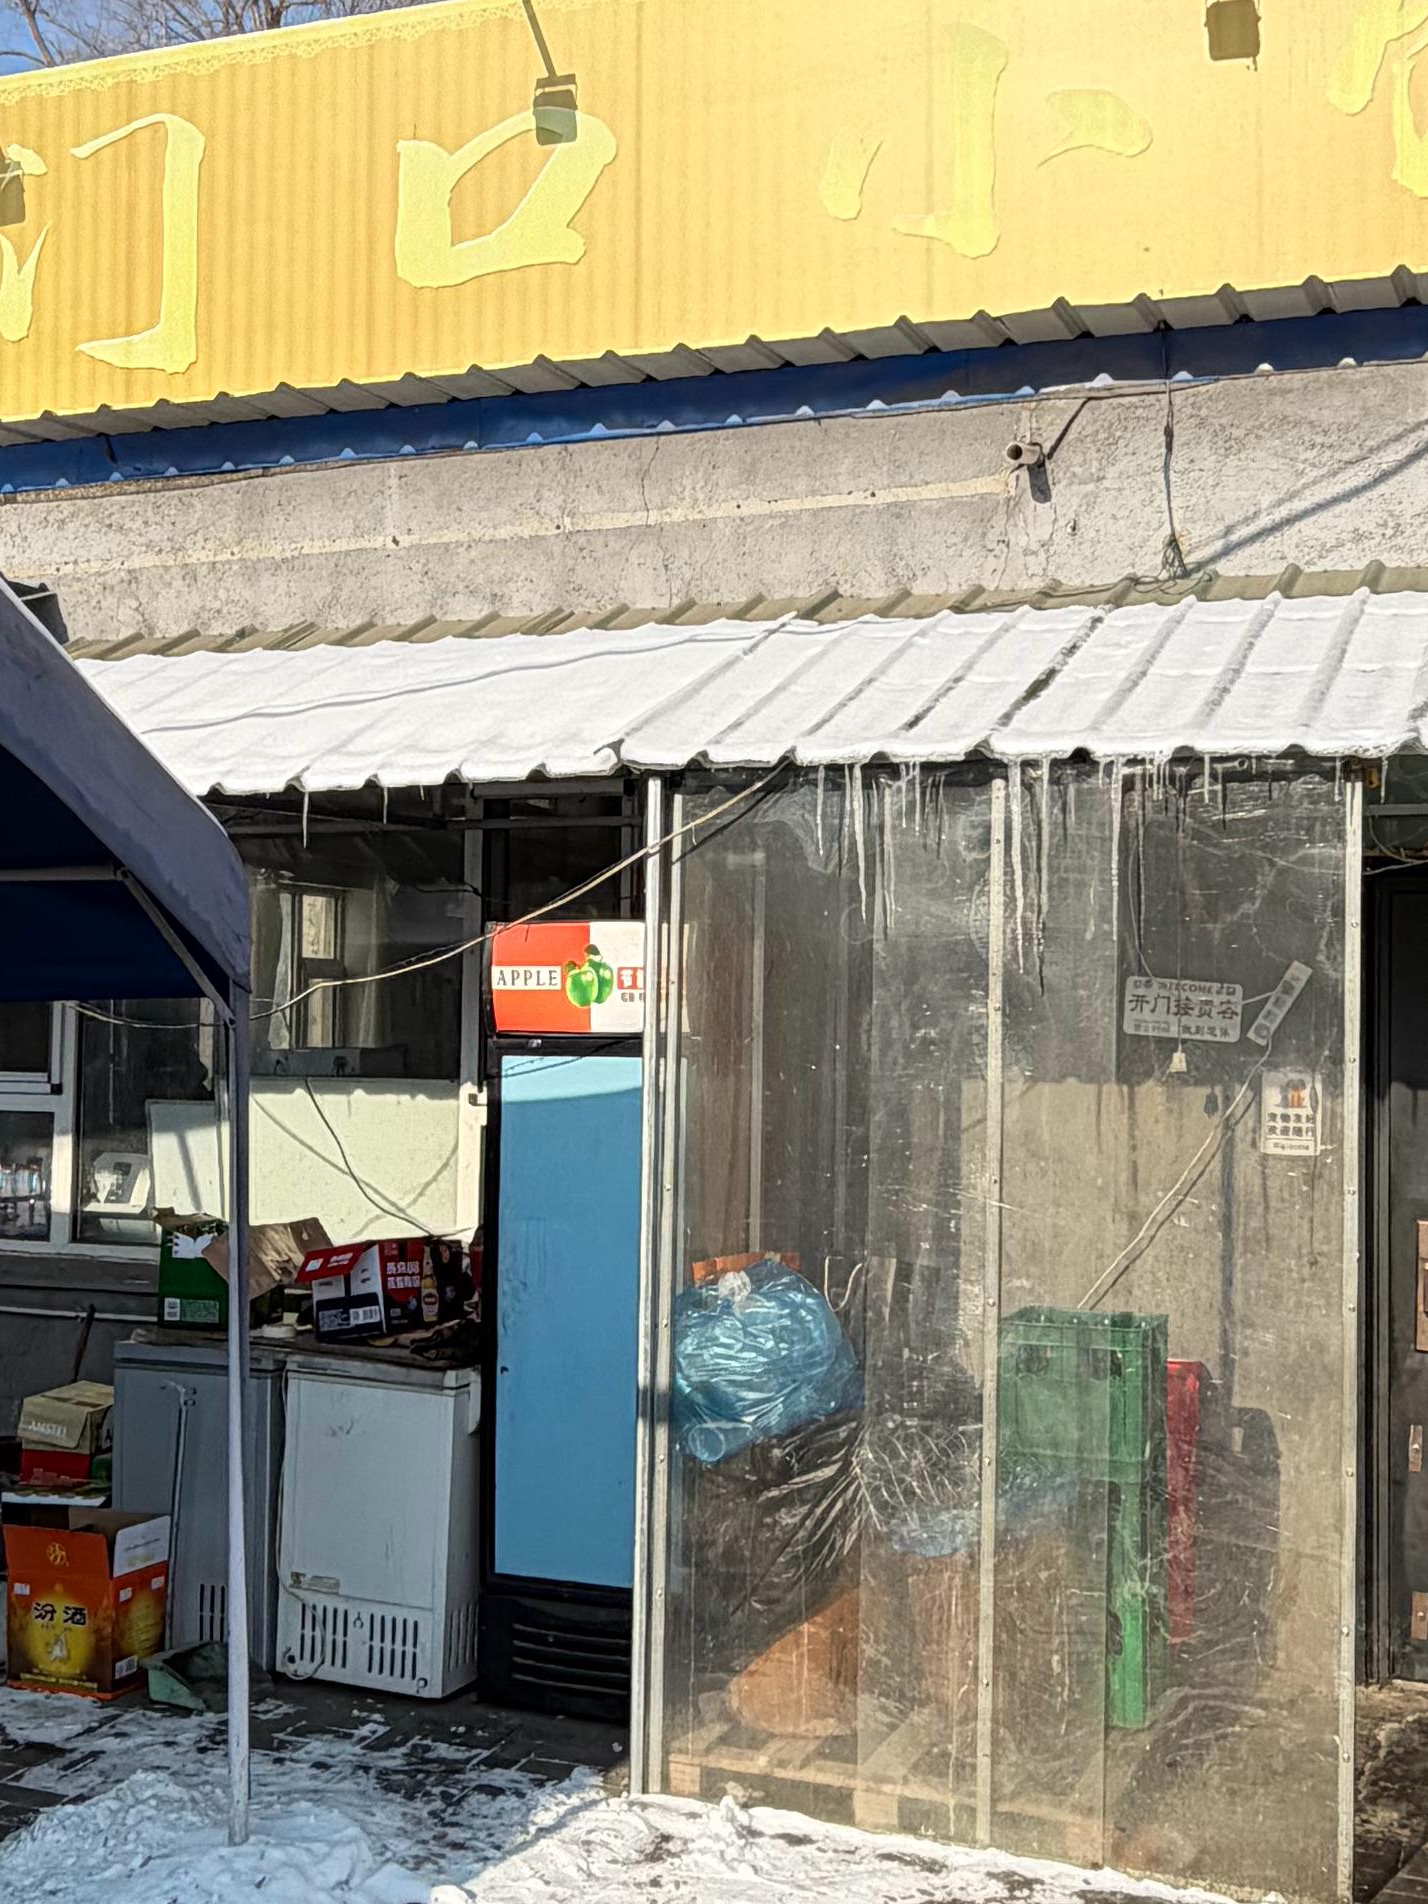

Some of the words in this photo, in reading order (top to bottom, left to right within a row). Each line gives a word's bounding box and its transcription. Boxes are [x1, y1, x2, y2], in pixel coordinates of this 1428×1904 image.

[496, 969, 559, 987] APPLE
[1128, 994, 1240, 1020] 开门接贵客
[32, 1601, 89, 1627] 汾酒
